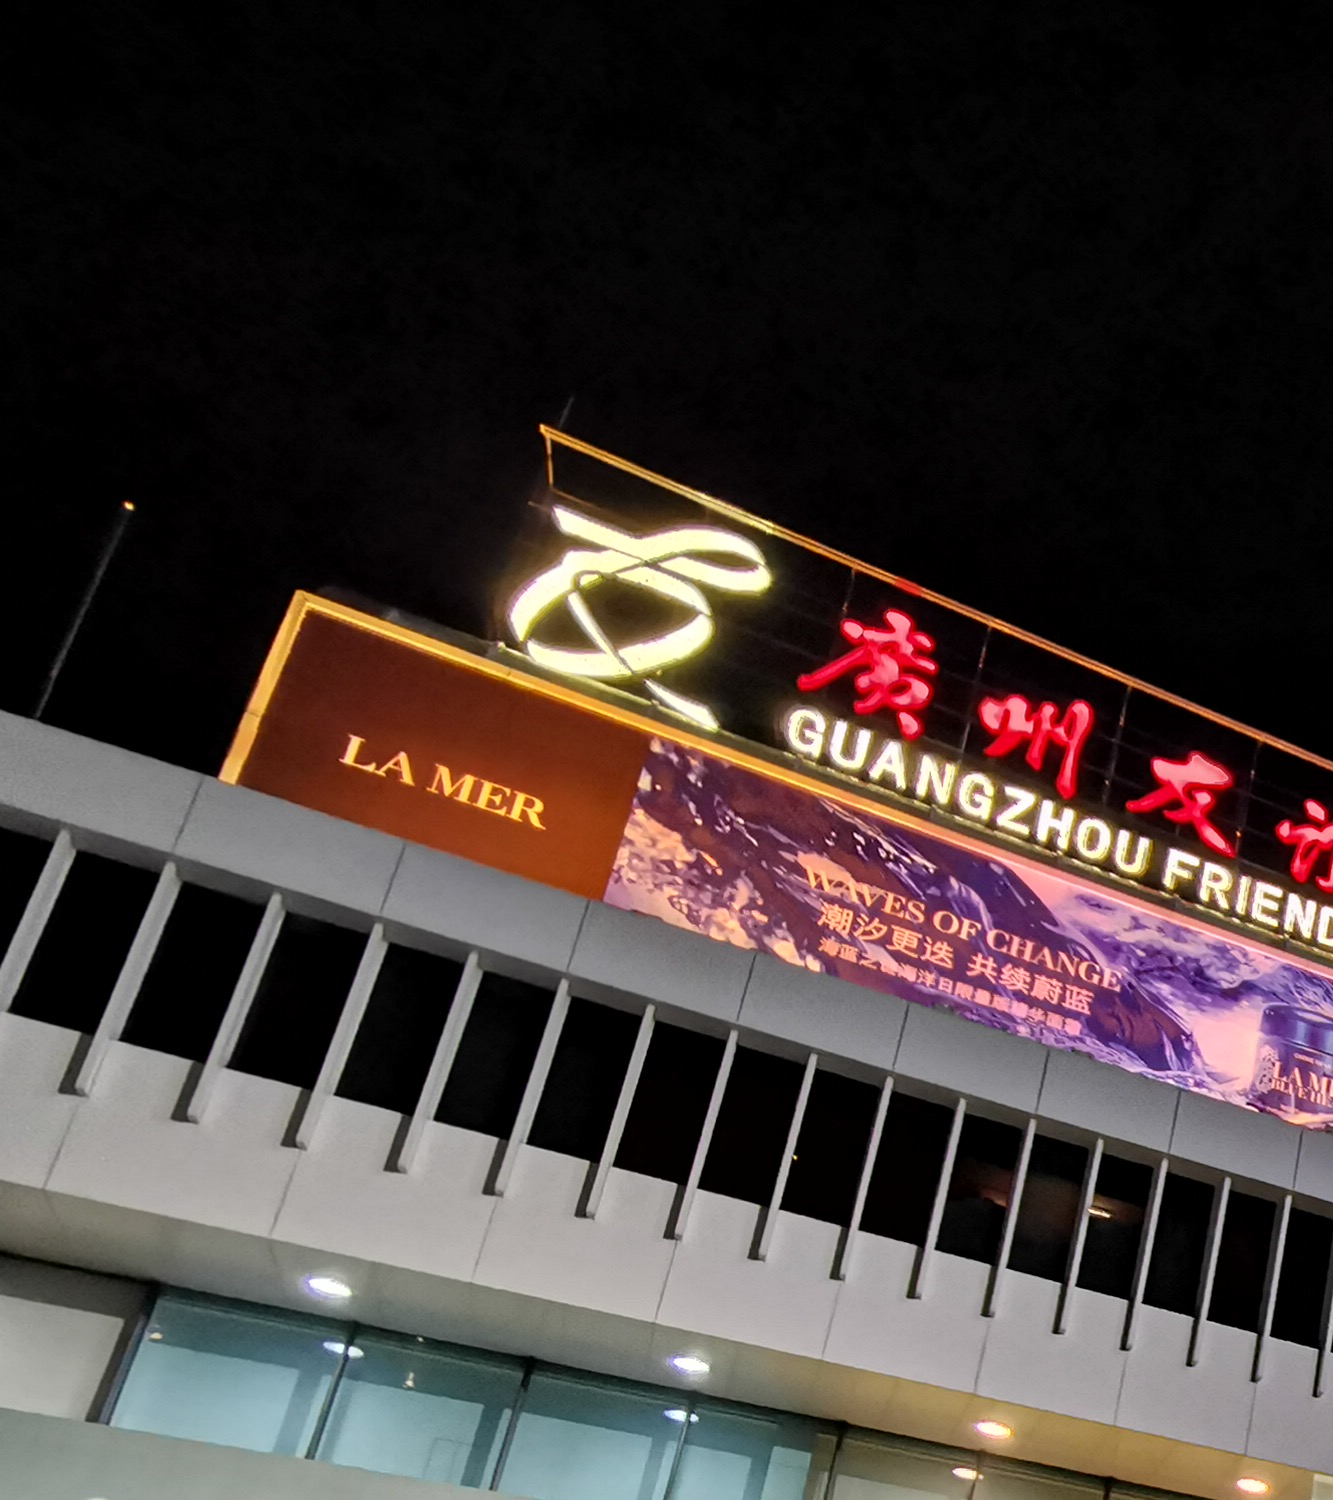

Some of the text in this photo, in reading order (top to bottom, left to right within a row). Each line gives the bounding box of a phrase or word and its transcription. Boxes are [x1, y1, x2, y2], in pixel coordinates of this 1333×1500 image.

[338, 733, 547, 830] LA MER
[786, 707, 1154, 879] GUANGZHOU
[805, 864, 1122, 993] WAVES OF CHANGE
[816, 900, 1095, 1016] 潮汐更迭 共续蔚蓝
[1273, 1060, 1304, 1088] LA
